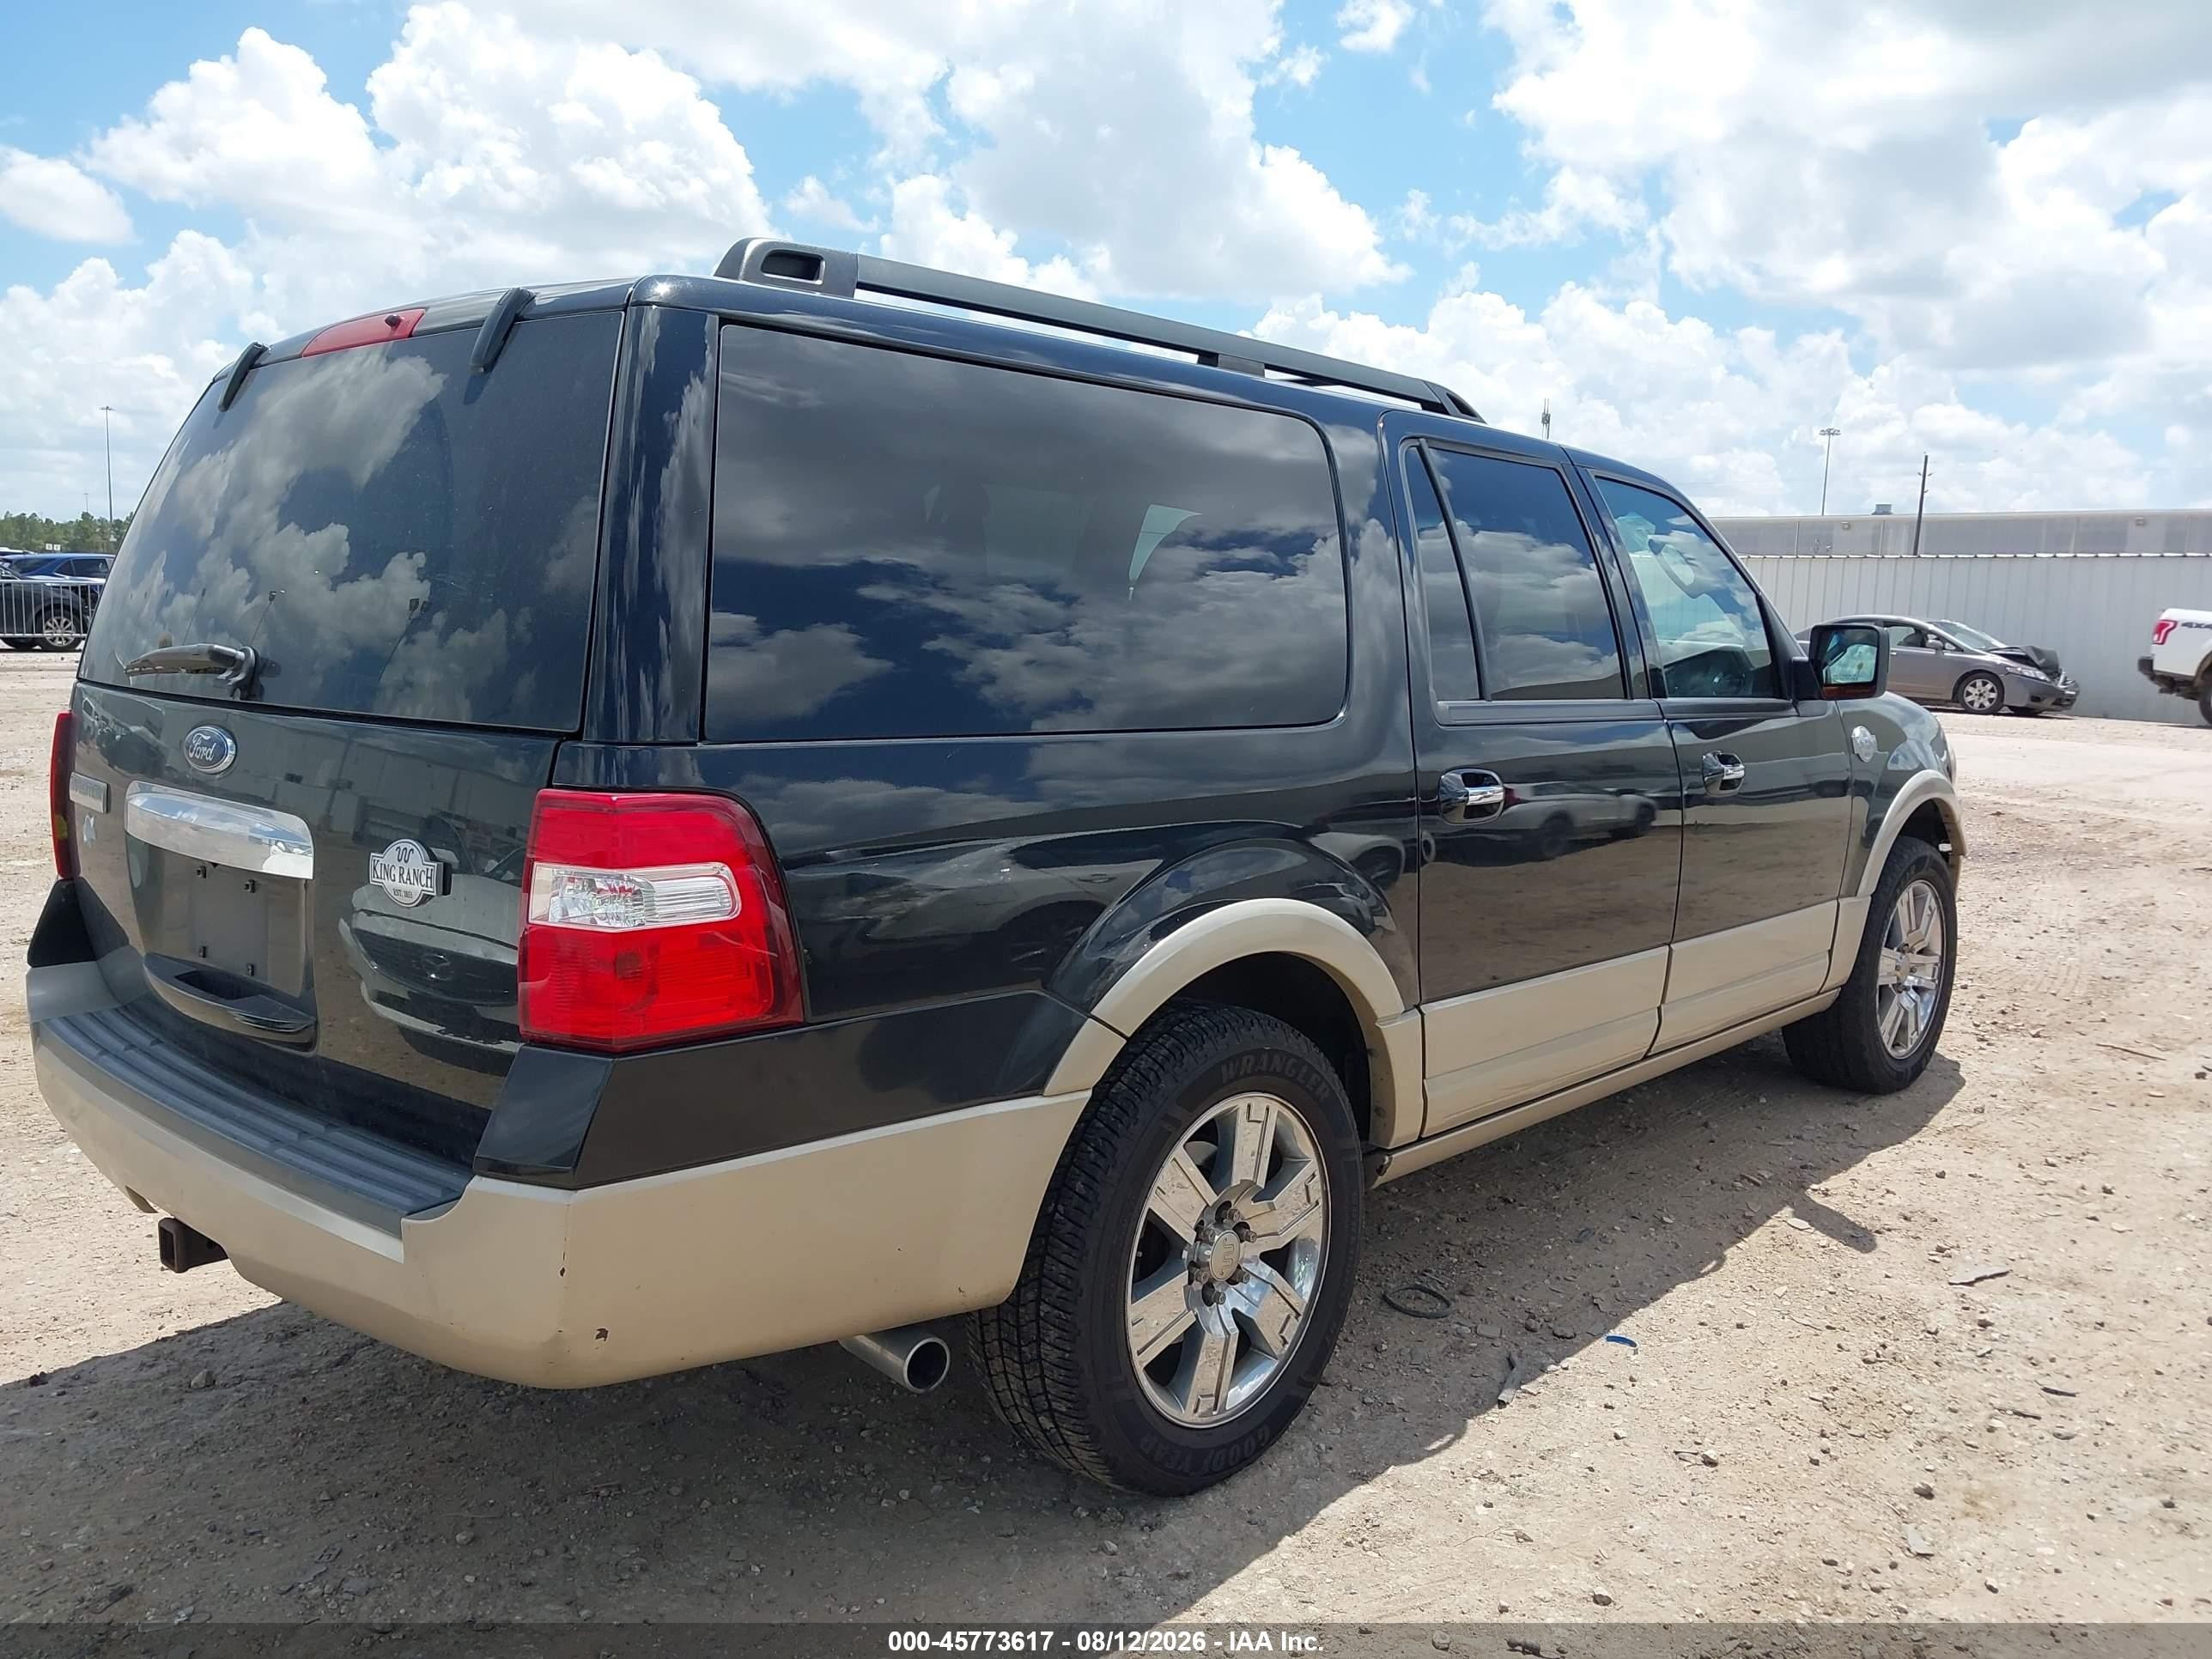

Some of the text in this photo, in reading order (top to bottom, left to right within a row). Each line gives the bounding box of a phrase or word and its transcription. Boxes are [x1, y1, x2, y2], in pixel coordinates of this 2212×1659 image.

[189, 732, 217, 762] Ford
[372, 859, 434, 889] KING RANCH
[1220, 1052, 1330, 1102] WRANGLER
